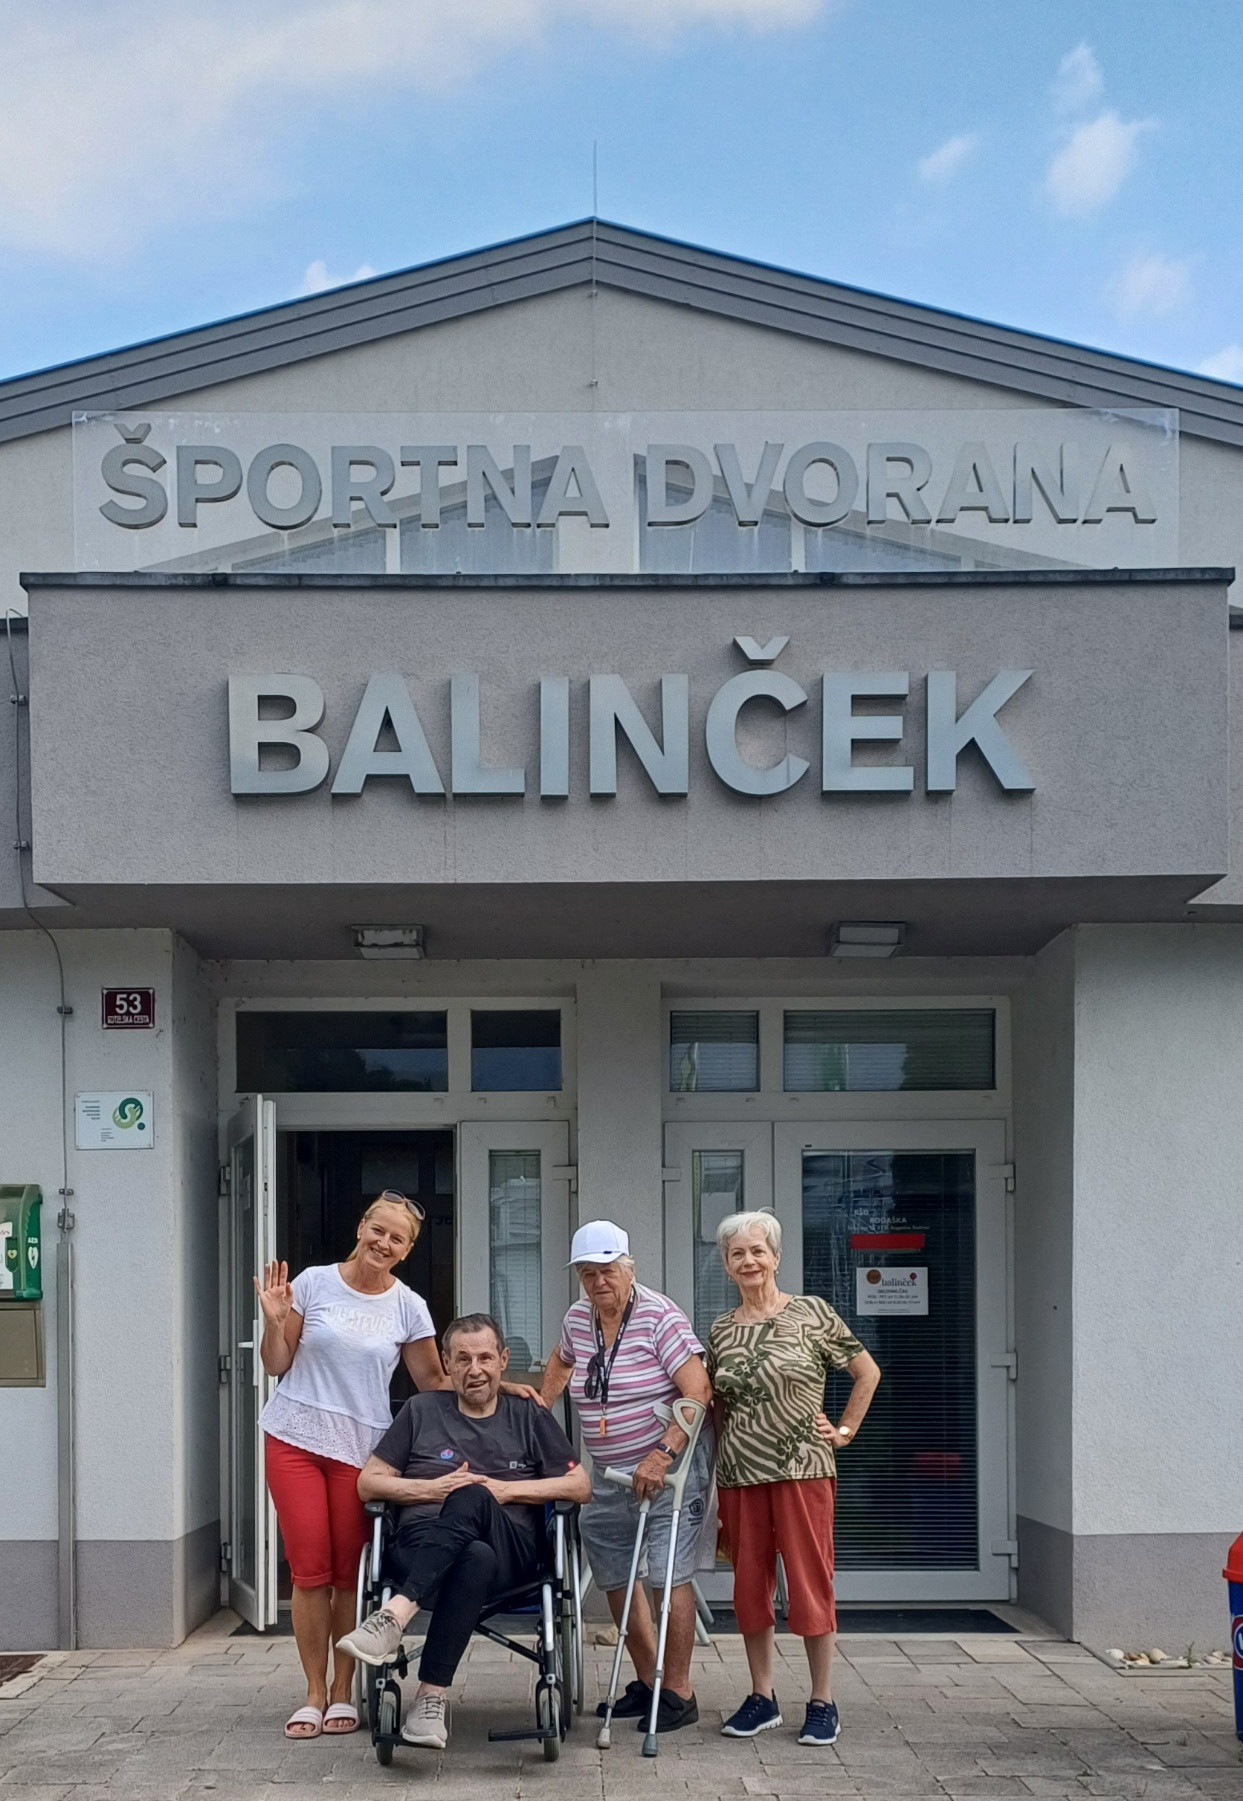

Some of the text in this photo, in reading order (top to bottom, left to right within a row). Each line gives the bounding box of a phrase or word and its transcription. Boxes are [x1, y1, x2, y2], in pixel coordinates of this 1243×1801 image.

[99, 423, 1158, 530] ŠPORTNA DVORANA
[228, 636, 1037, 800] BALINČEK
[115, 993, 142, 1014] 53
[881, 1277, 917, 1287] balinček
